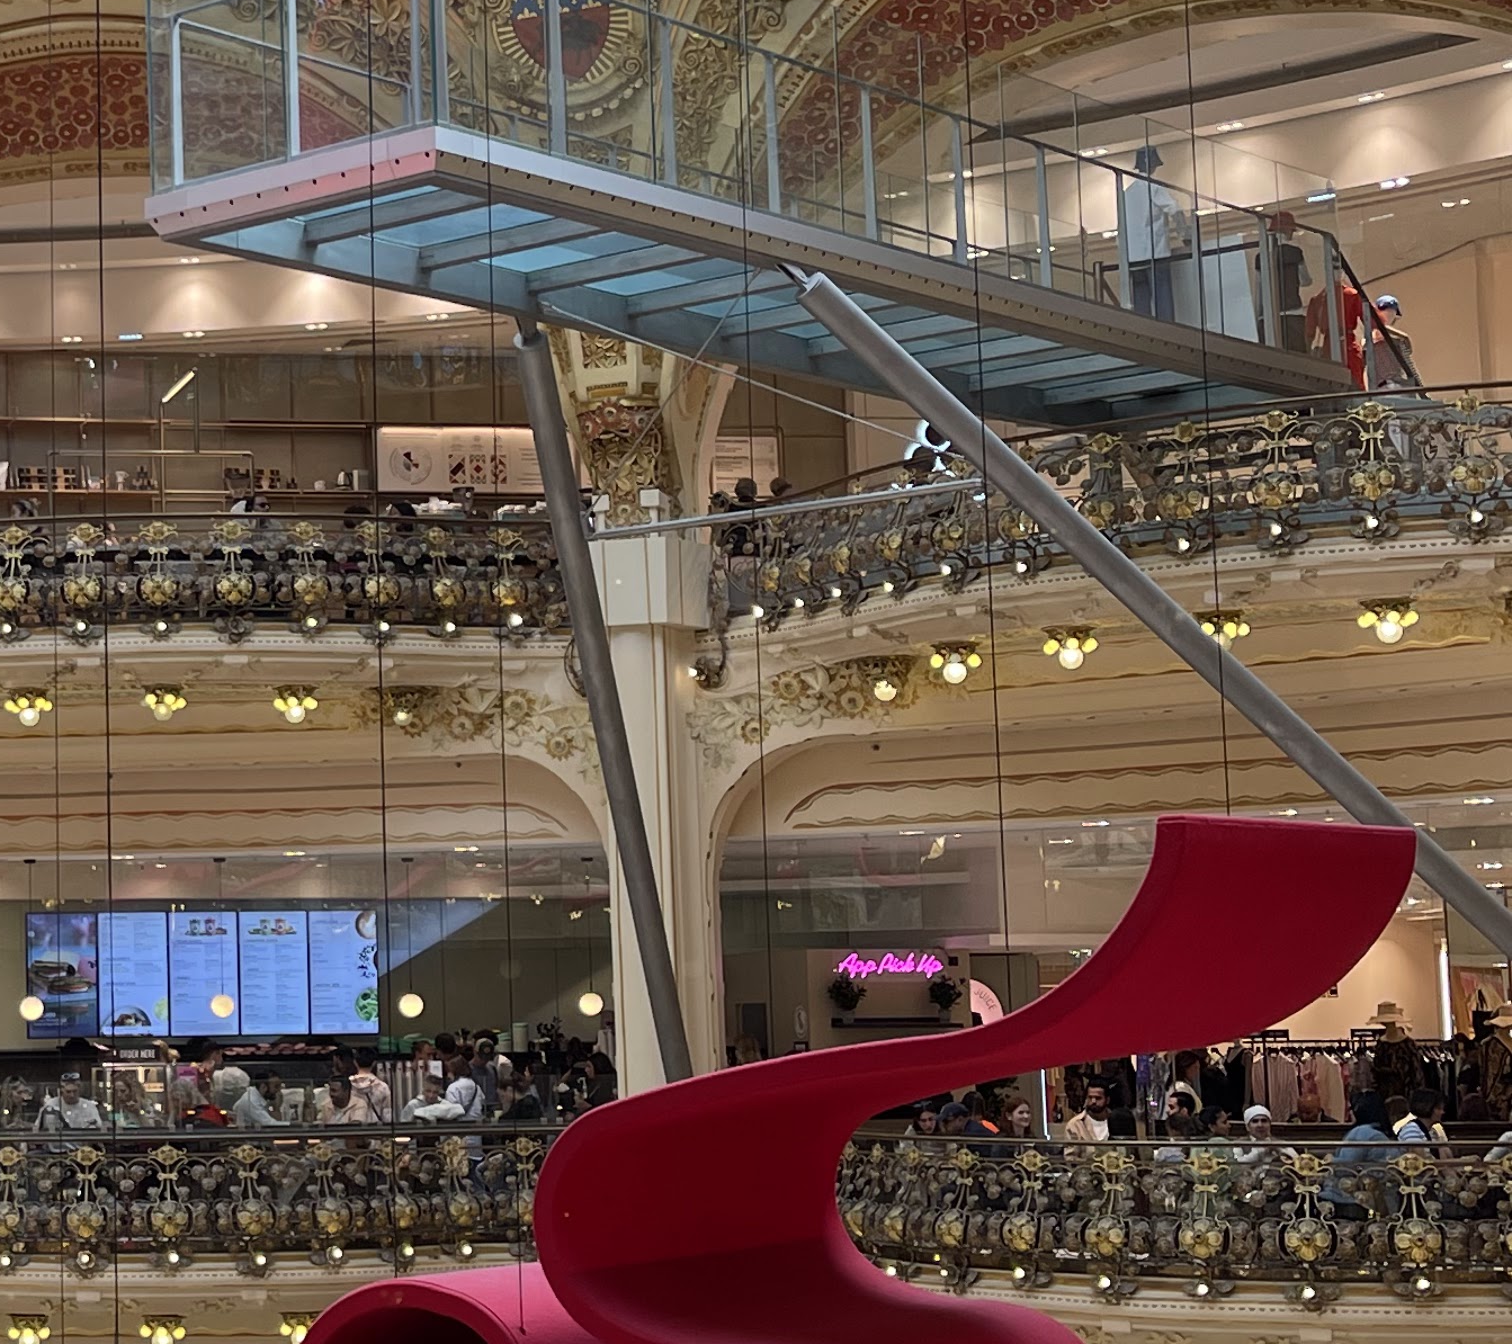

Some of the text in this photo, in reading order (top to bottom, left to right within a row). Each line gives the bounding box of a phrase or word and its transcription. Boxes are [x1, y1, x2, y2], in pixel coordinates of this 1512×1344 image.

[838, 951, 945, 979] App Pick Up
[973, 988, 997, 1012] JUICE
